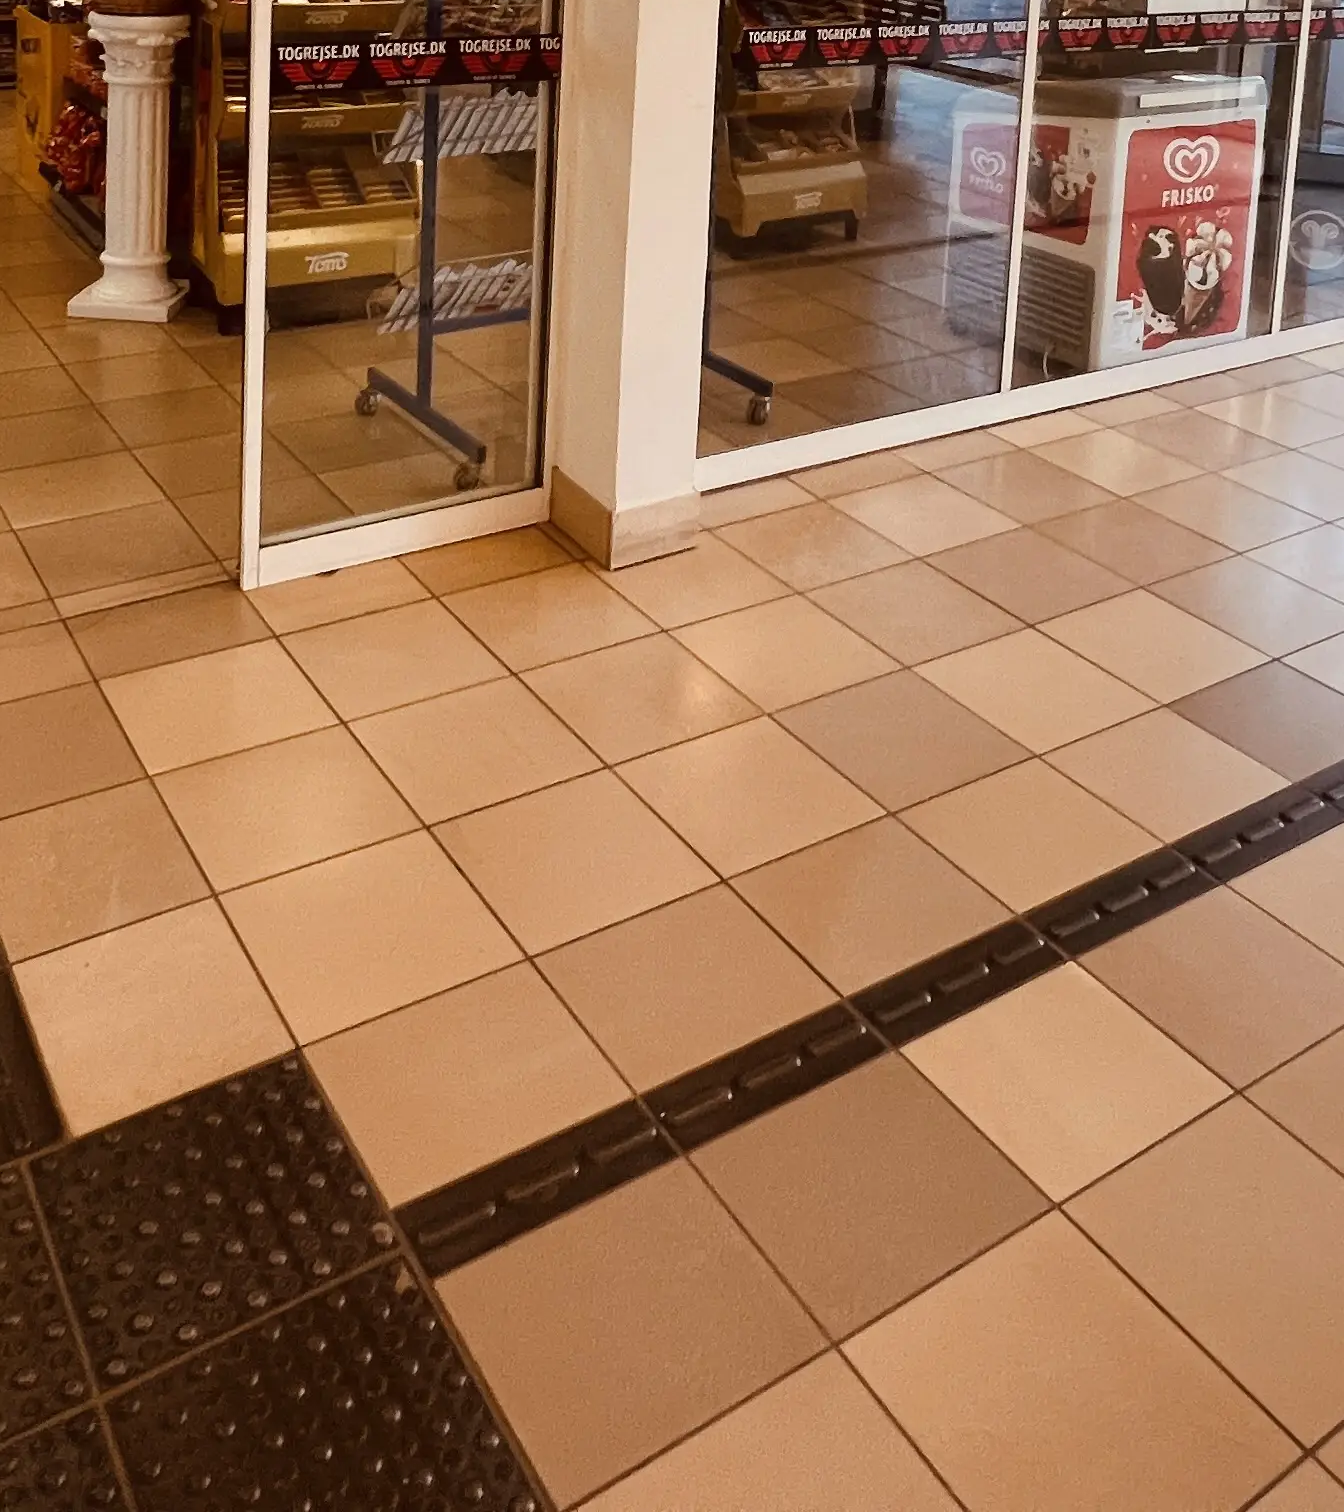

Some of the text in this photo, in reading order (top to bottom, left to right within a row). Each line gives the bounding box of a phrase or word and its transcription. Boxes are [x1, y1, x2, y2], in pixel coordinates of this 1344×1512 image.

[277, 44, 360, 63] TOGREJSE.DK
[370, 41, 447, 59] TOGREJSE.DK
[459, 38, 531, 55] TOGREJSE.DK
[1161, 186, 1215, 208] FRISKO
